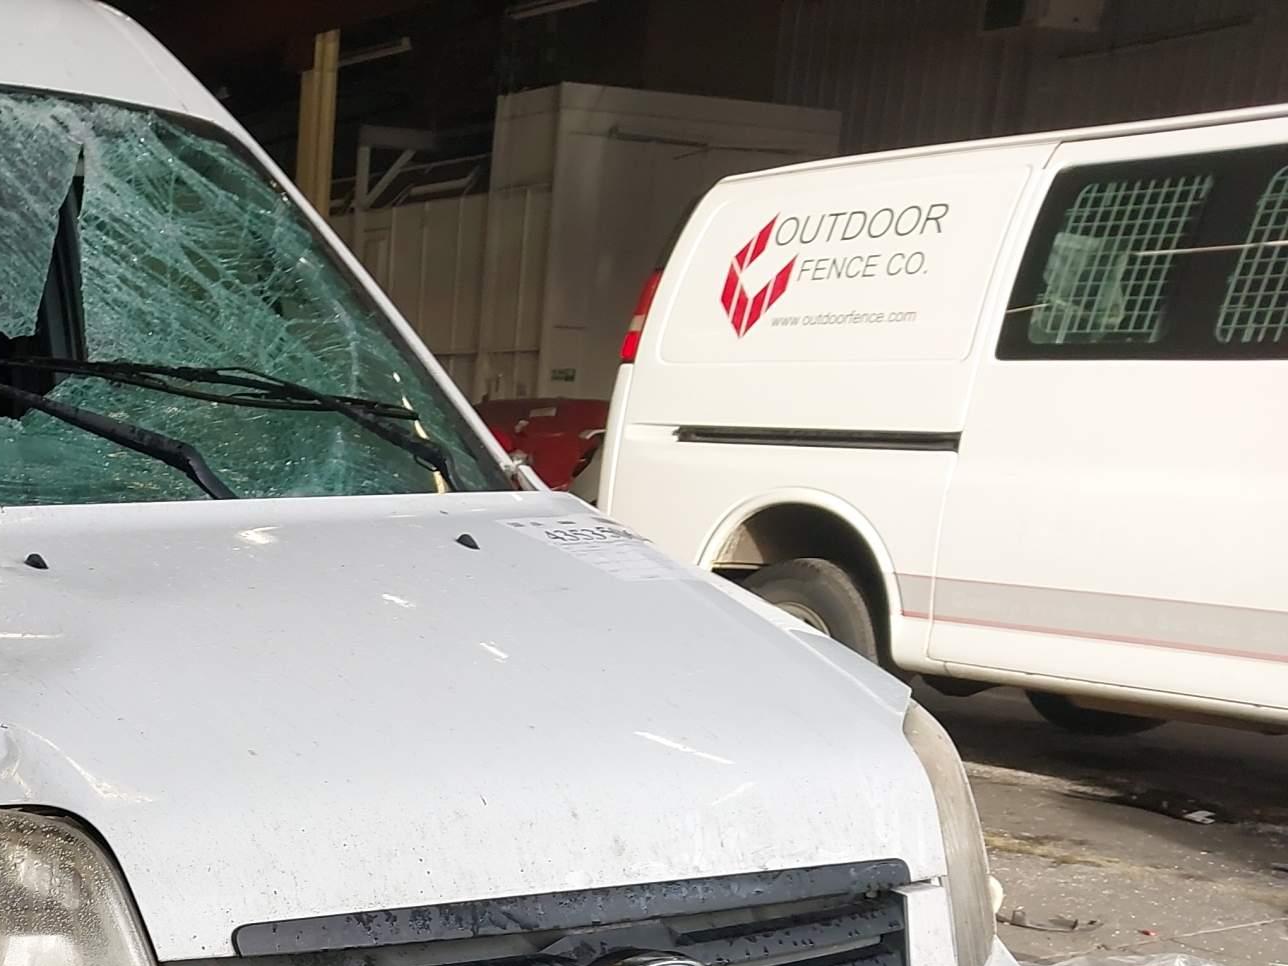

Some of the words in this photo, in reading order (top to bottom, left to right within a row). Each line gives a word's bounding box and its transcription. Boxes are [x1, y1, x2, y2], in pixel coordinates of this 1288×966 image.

[775, 203, 949, 246] OUTDOOR
[797, 254, 882, 282] FENCE
[886, 251, 928, 276] CO.
